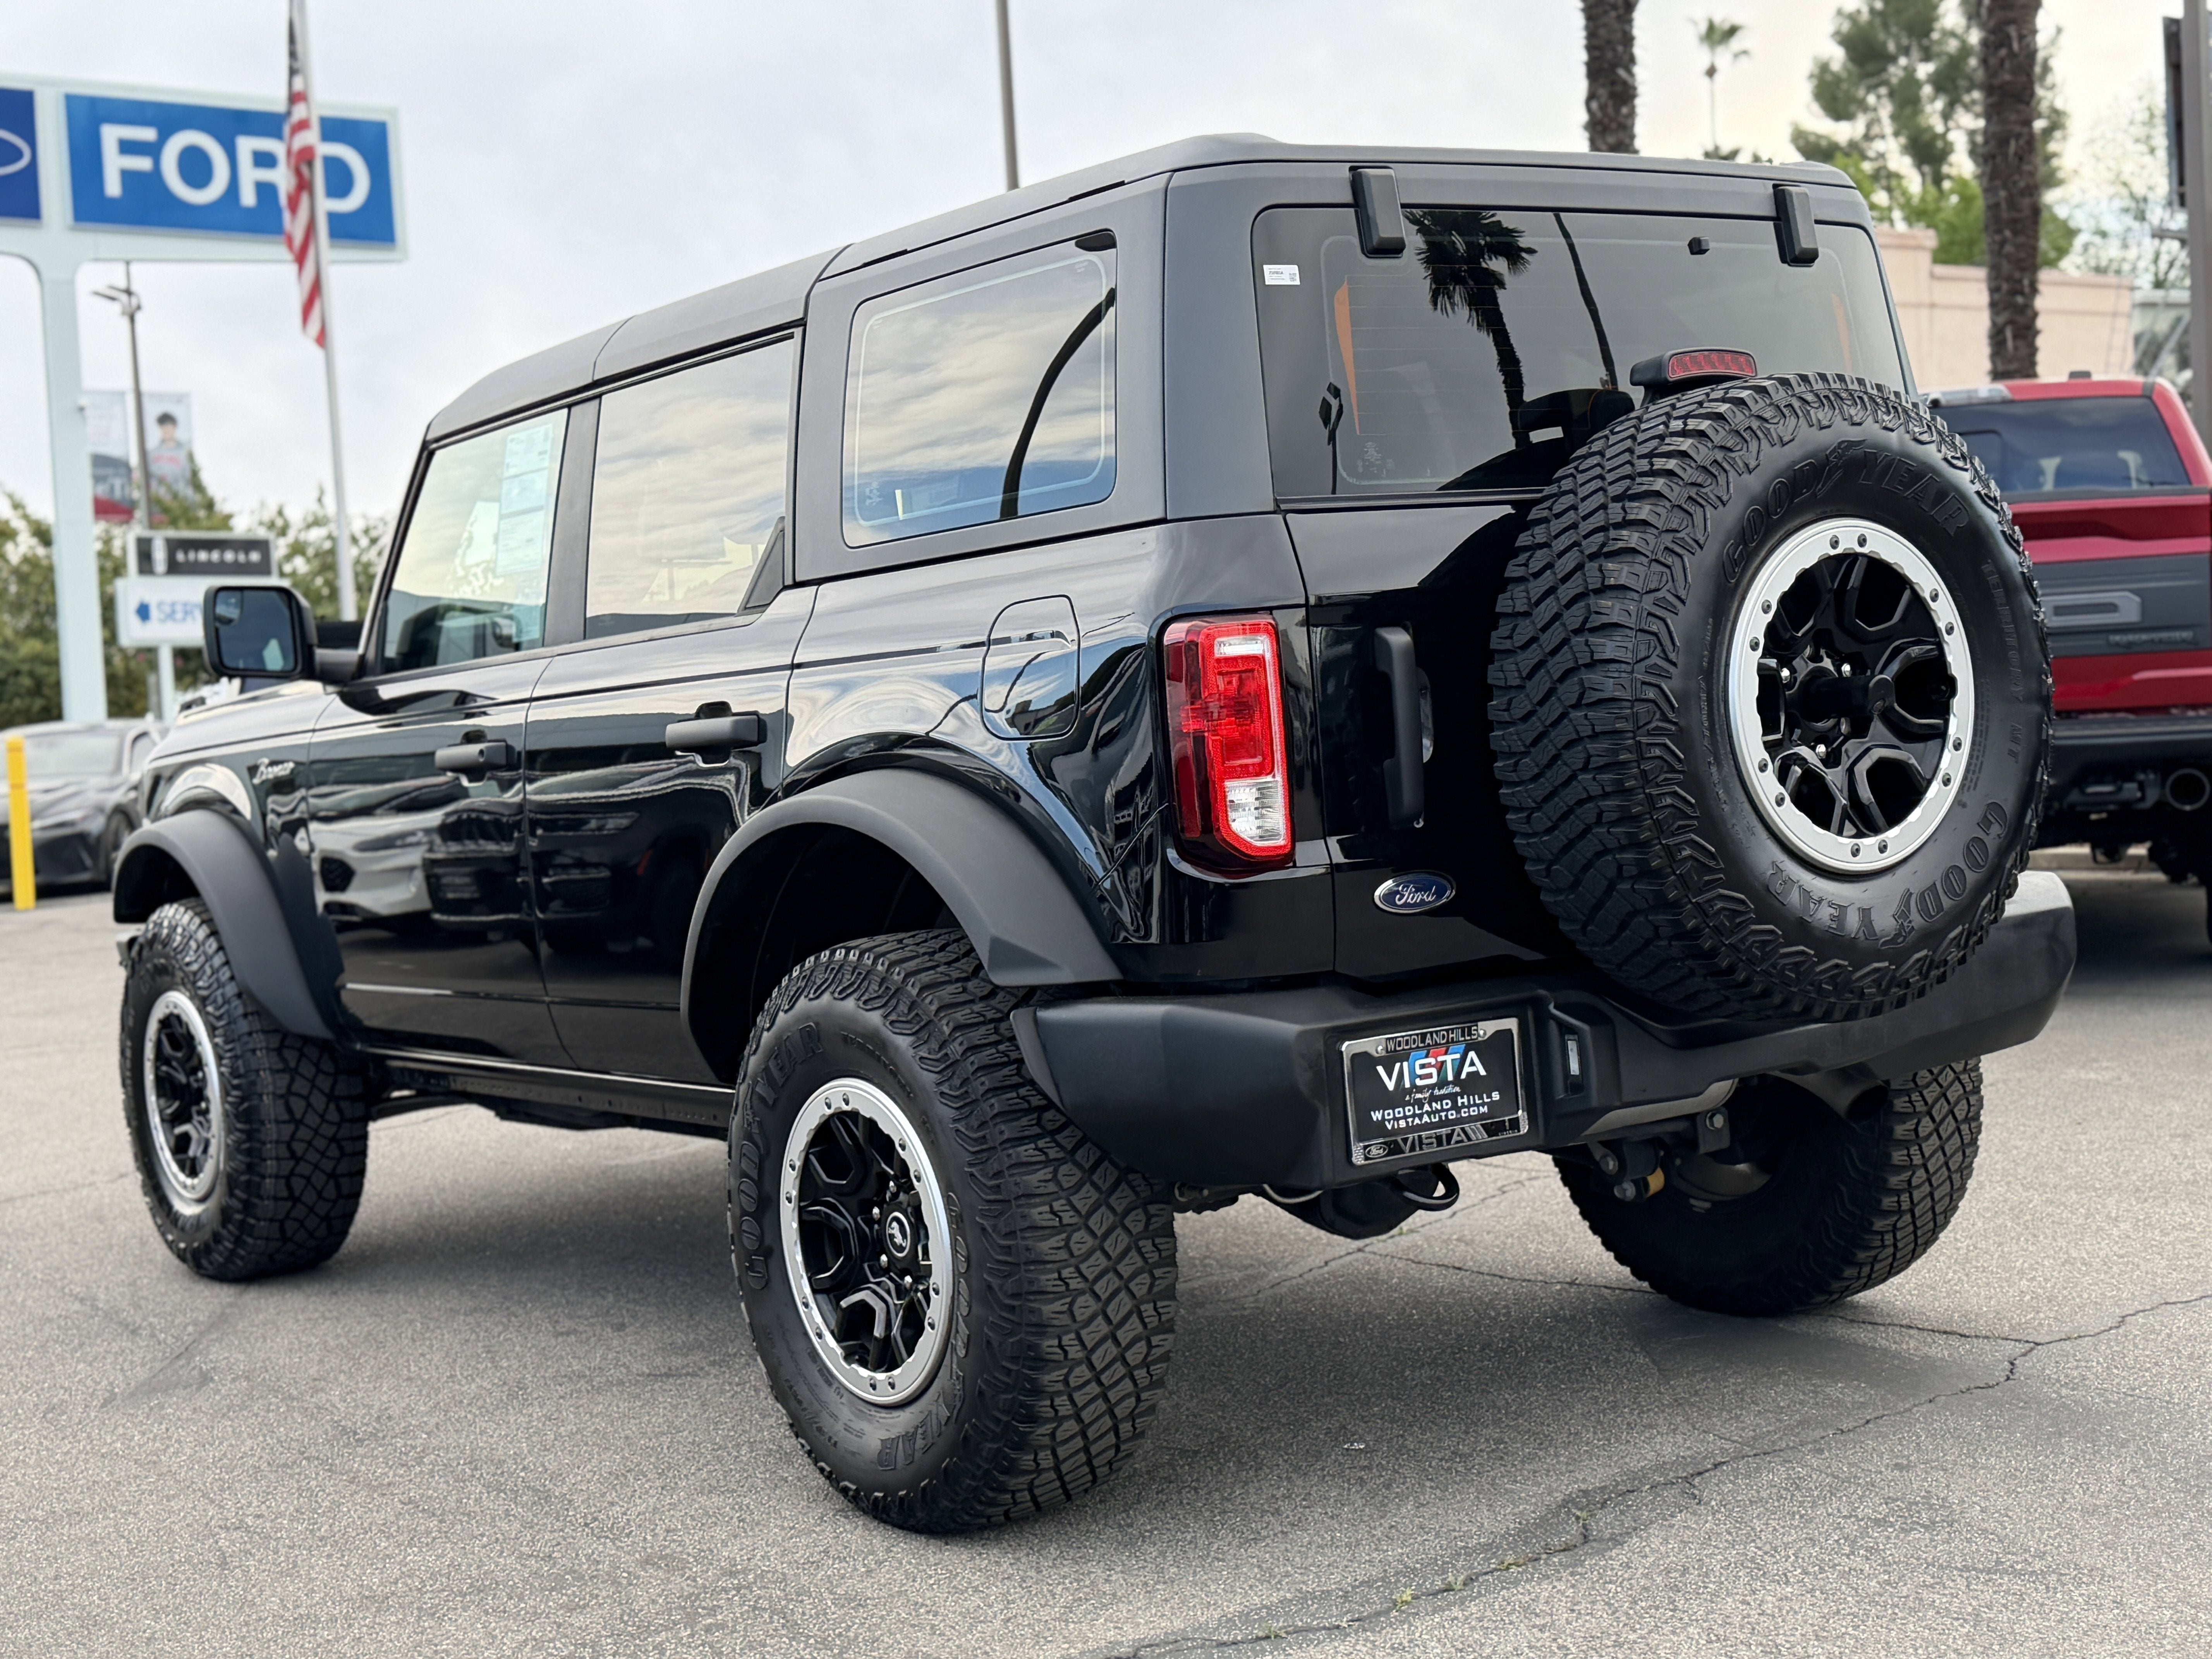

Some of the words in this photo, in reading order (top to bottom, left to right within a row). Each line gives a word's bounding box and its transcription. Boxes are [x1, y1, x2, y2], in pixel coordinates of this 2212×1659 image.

[100, 123, 370, 213] FORD
[175, 549, 262, 564] LINCOLN
[1395, 883, 1436, 905] Ford
[1386, 1030, 1447, 1052] WOODLAND
[1449, 1026, 1478, 1042] HILLS
[1376, 1051, 1487, 1091] VISTA
[1396, 1128, 1468, 1154] VISTA
